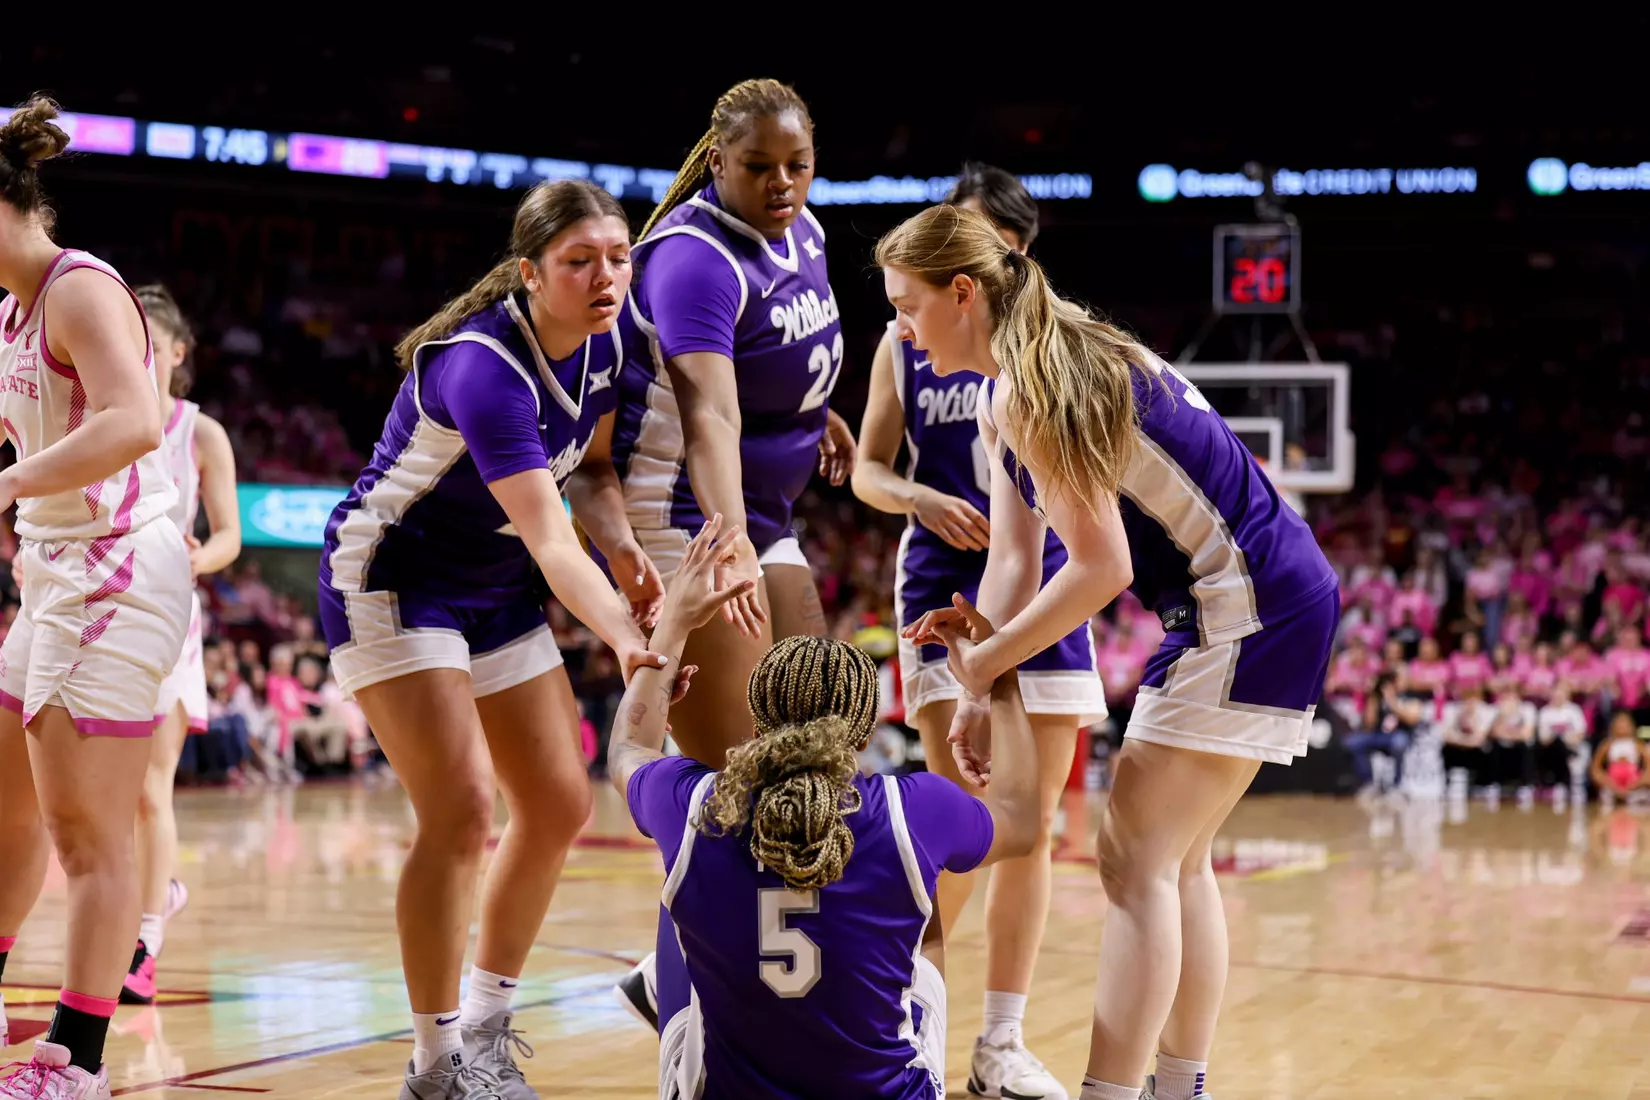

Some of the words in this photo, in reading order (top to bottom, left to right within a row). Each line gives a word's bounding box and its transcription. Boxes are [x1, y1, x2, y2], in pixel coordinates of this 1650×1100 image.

[1396, 167, 1476, 194] UNION
[1230, 257, 1285, 303] 20
[8, 375, 39, 400] ATE
[798, 331, 844, 413] 22
[917, 381, 979, 426] Wil
[757, 888, 822, 998] 5
